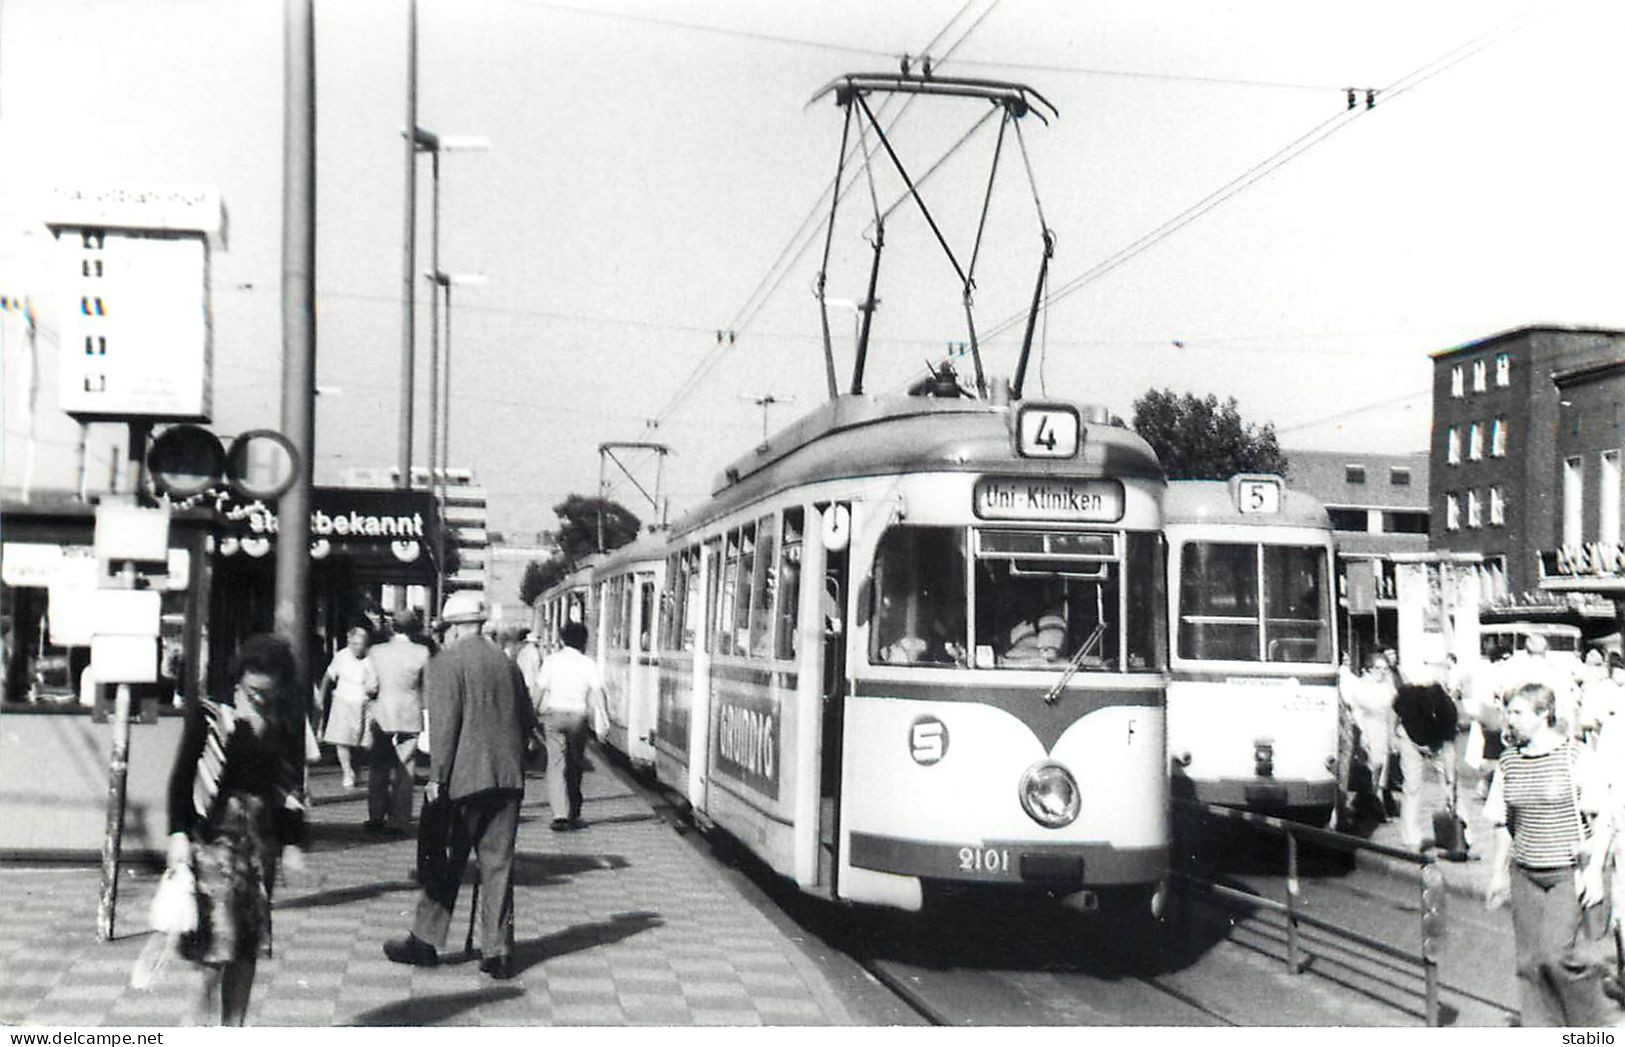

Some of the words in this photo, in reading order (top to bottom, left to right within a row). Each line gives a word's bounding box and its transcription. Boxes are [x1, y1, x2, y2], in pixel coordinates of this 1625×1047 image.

[1034, 415, 1057, 451] 4
[1251, 485, 1264, 510] 5
[720, 703, 773, 780] GRUNDIG
[958, 846, 1010, 872] 2101
